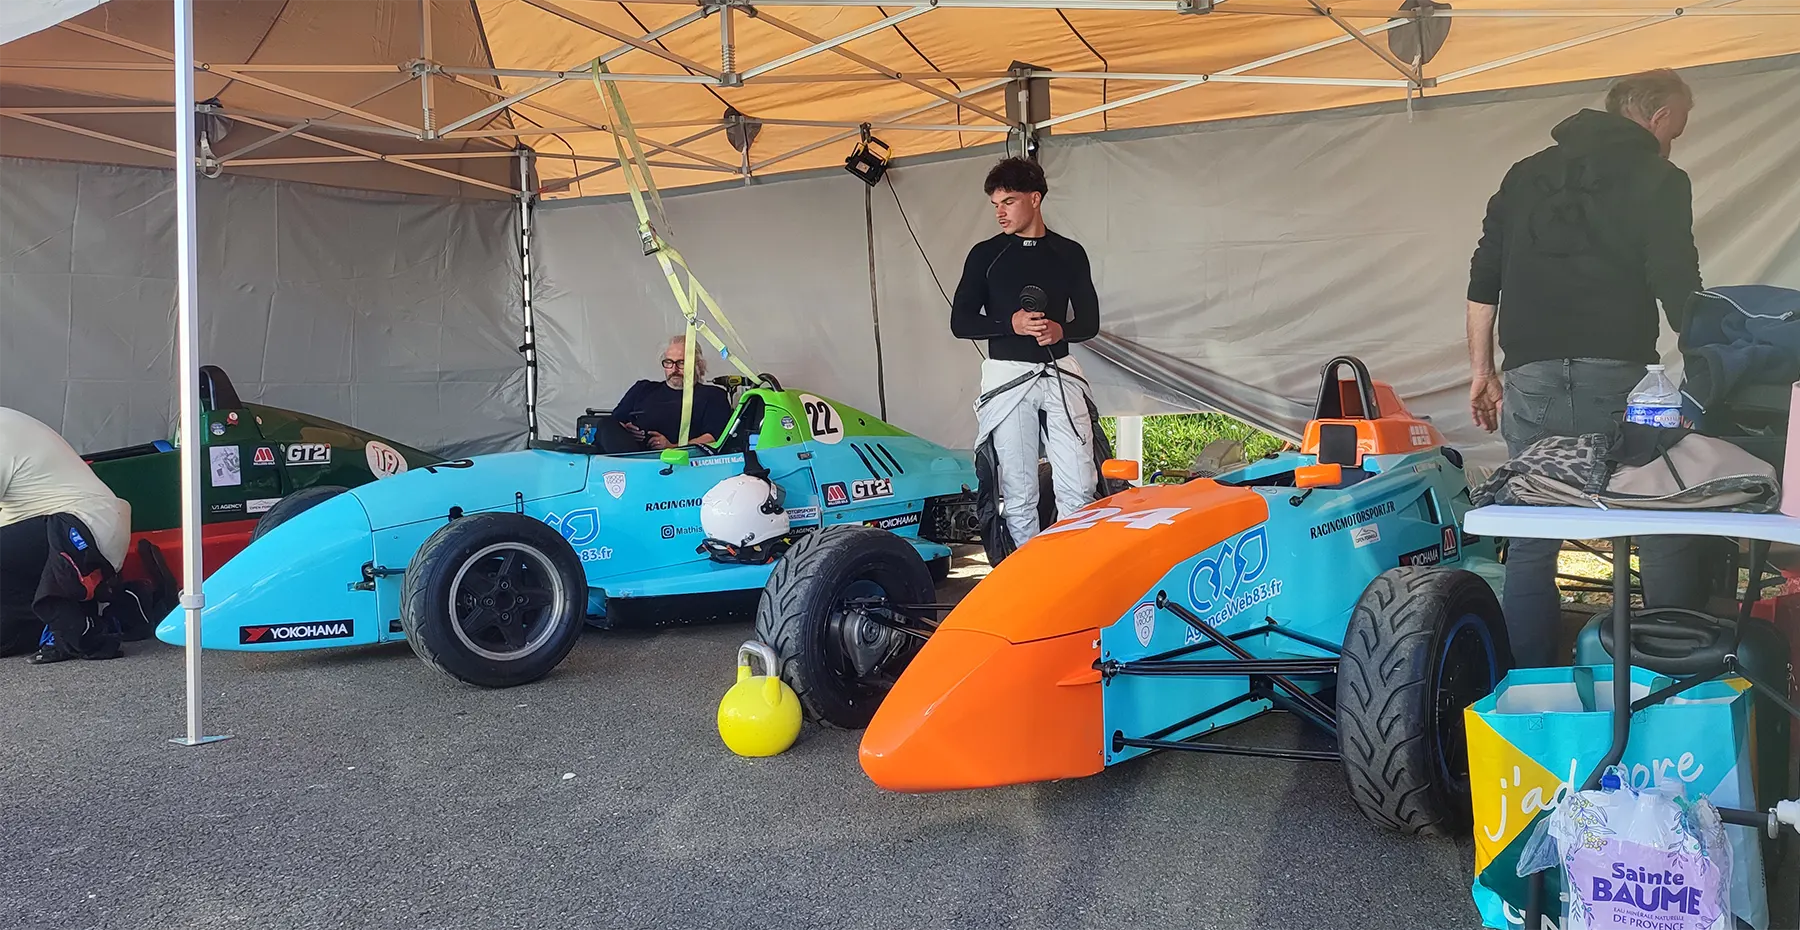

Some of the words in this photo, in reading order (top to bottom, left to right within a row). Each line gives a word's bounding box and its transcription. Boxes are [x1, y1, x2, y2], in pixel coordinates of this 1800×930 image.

[805, 401, 839, 436] 22
[287, 443, 331, 462] GT2i
[852, 478, 893, 499] GT2i
[645, 497, 703, 512] RACINGMO
[676, 525, 703, 535] Mathis
[879, 514, 918, 529] YOKOHAMA
[1036, 507, 1192, 537] 24
[1310, 501, 1396, 540] RACINGMOTORSPORT.FR
[1410, 549, 1439, 566] YOKOHAMA
[1185, 579, 1283, 644] AgnceWeb83.fr
[270, 623, 349, 639] YOKOHAMA
[1611, 862, 1685, 886] Sainte
[1592, 876, 1702, 916] BAUME
[1613, 914, 1627, 924] DE
